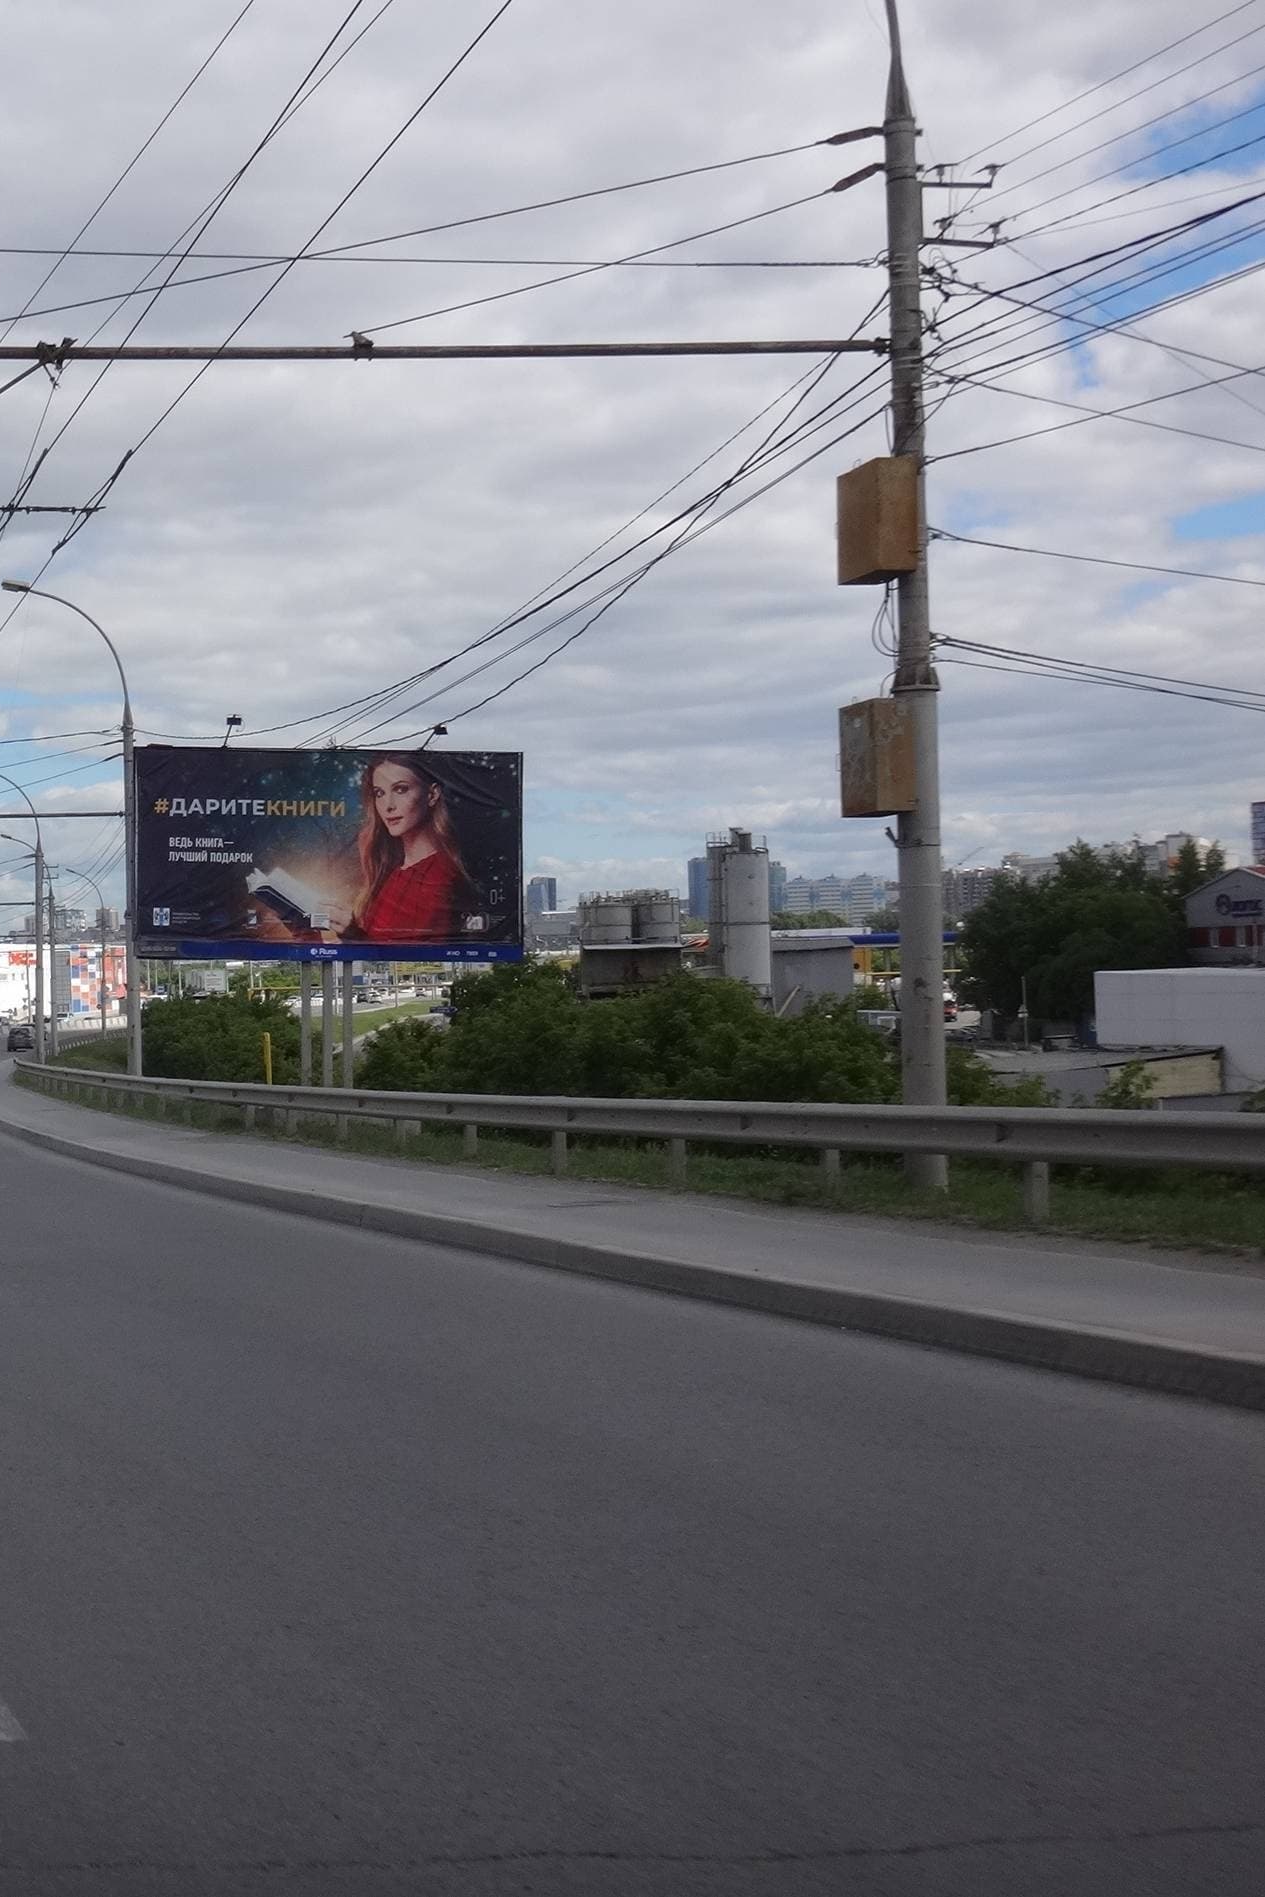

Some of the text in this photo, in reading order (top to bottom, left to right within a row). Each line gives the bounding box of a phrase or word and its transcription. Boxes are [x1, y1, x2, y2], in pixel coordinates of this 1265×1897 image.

[154, 798, 346, 817] #ДАРИТЕКНИГИ
[168, 837, 193, 848] ВЕДЬ
[168, 850, 253, 865] ЛУЧШИЙ ПОДАРОК
[490, 889, 506, 905] 0+
